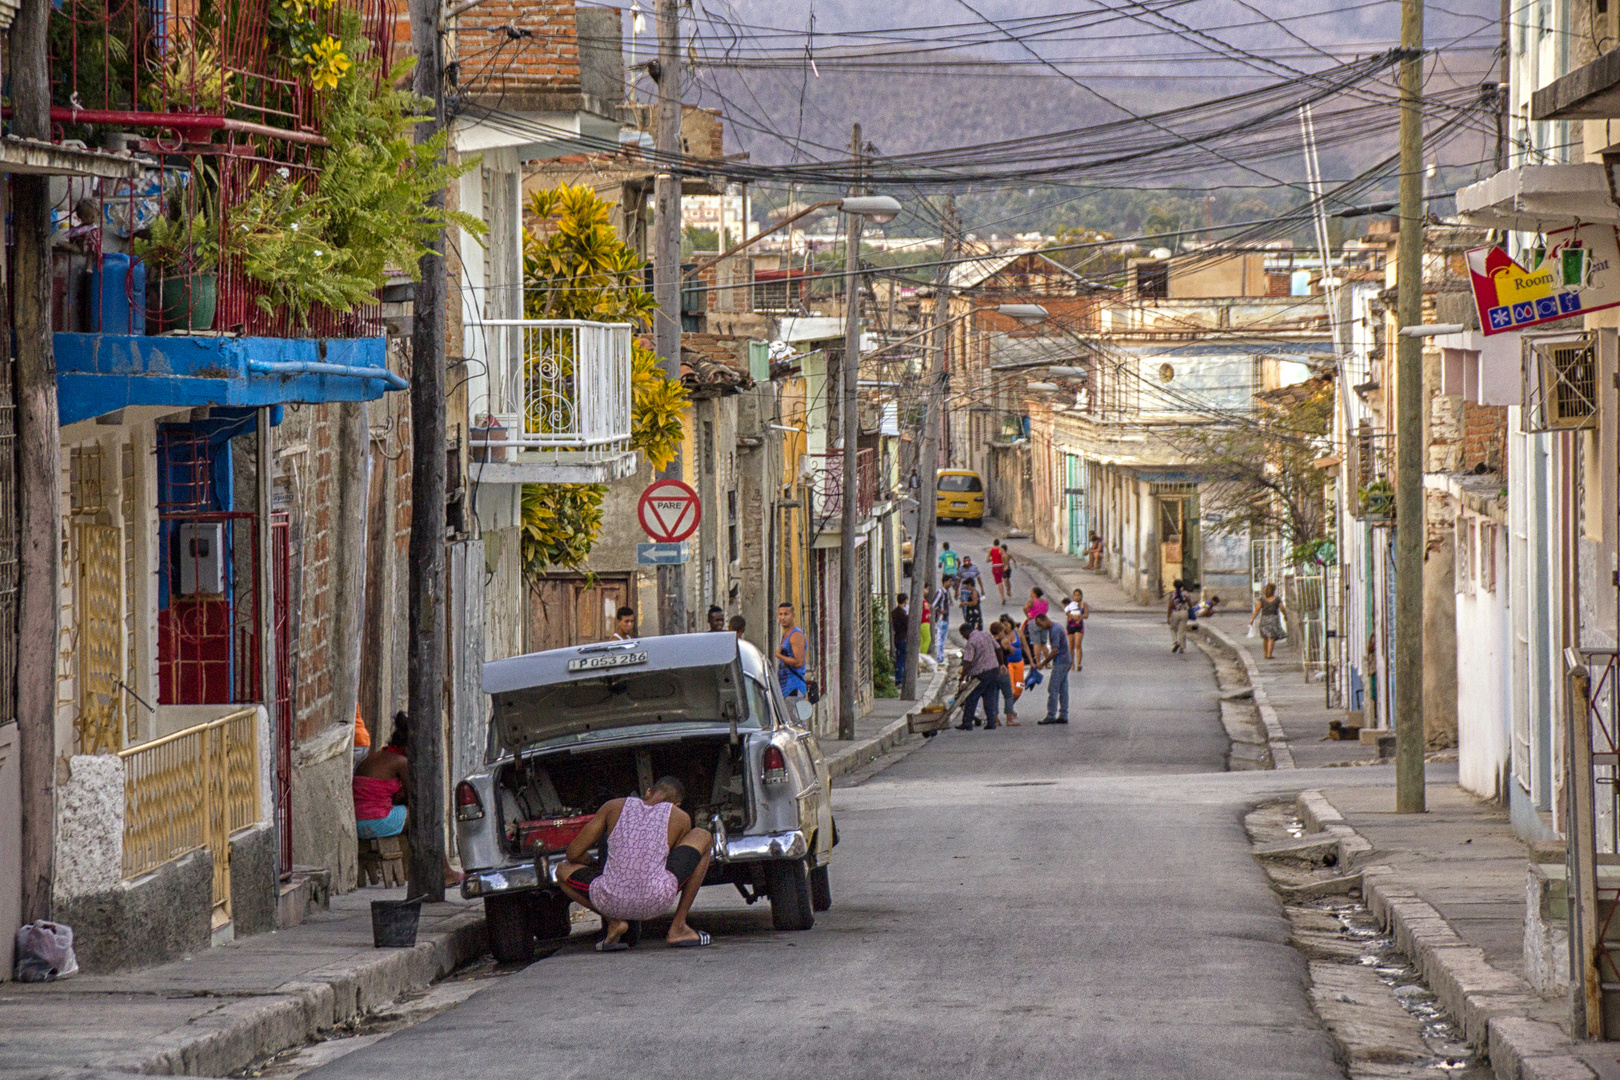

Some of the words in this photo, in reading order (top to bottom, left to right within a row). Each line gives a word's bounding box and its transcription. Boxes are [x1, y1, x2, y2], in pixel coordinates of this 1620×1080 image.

[1514, 273, 1554, 290] Room
[657, 501, 682, 510] PARE
[579, 658, 588, 668] P
[591, 656, 617, 668] 053
[620, 652, 646, 664] 286
